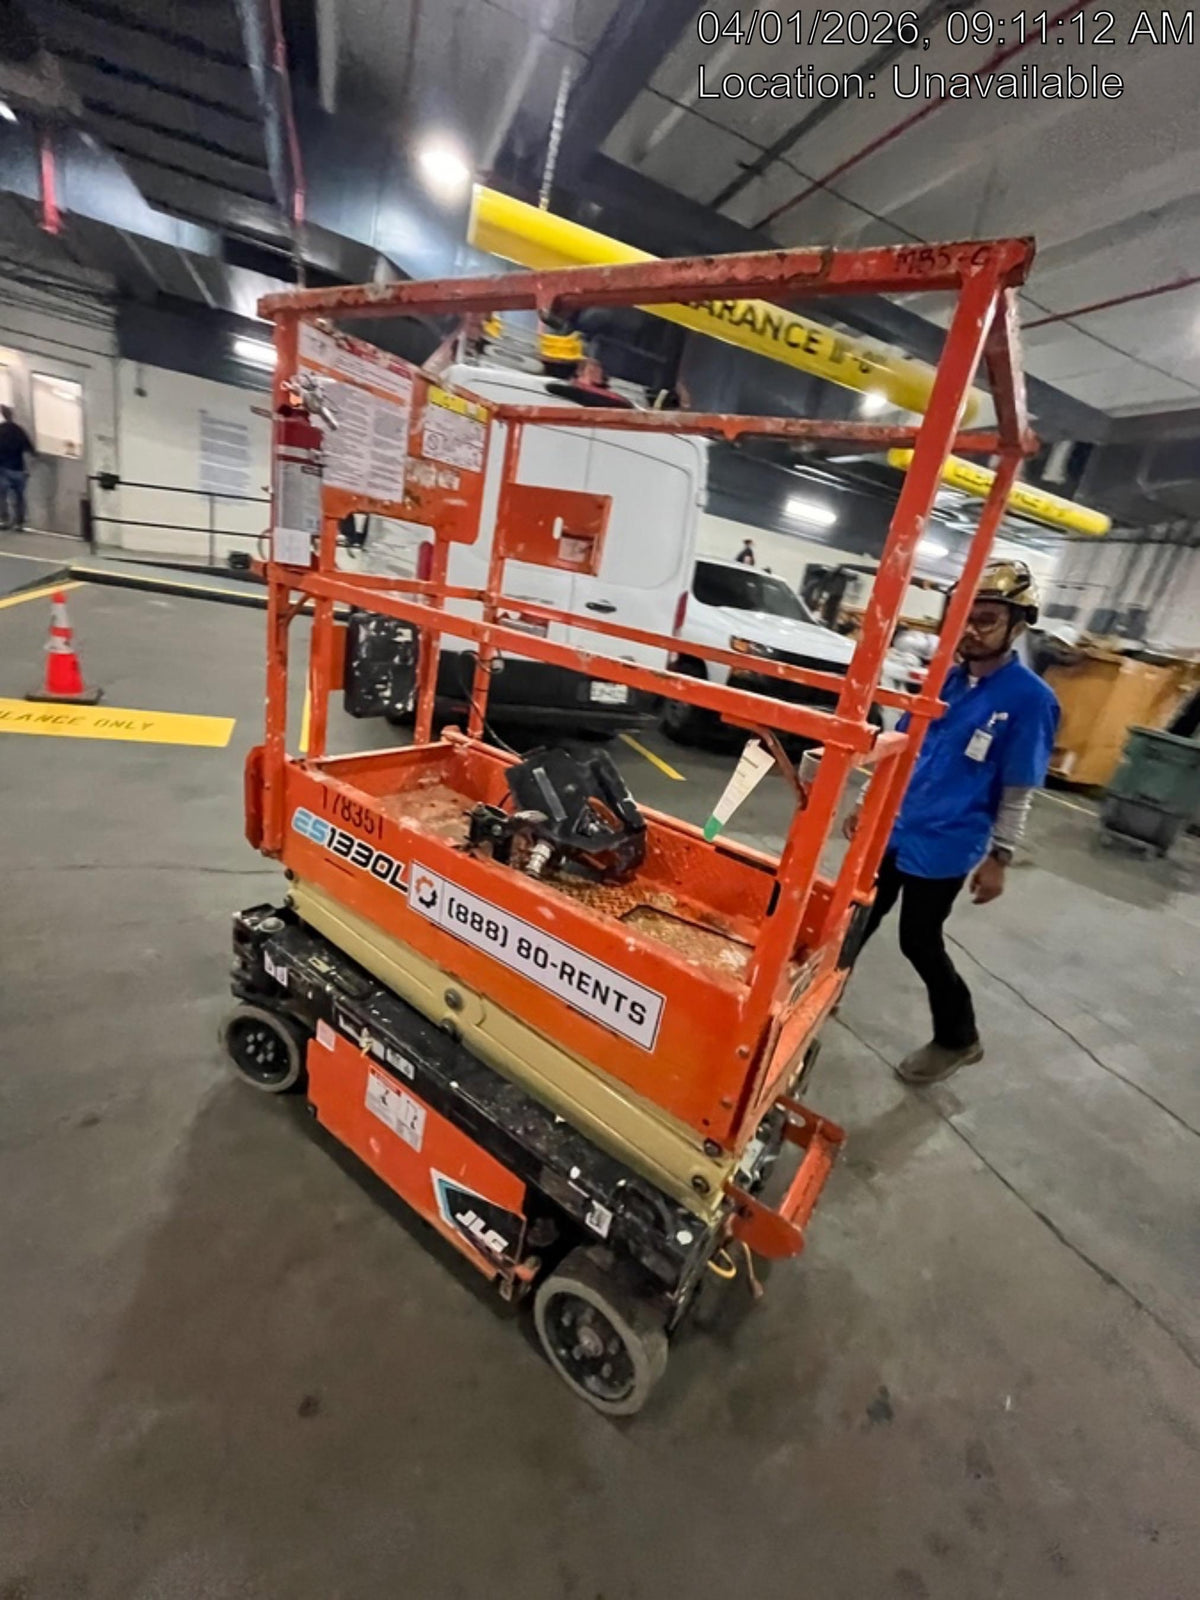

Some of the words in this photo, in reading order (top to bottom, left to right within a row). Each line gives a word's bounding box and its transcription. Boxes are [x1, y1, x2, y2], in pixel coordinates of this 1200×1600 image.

[322, 784, 383, 840] 178351
[291, 806, 409, 894] ES1330L
[447, 896, 508, 948] (888)
[516, 936, 647, 1026] 80-RENTS
[455, 1210, 509, 1253] JLG
